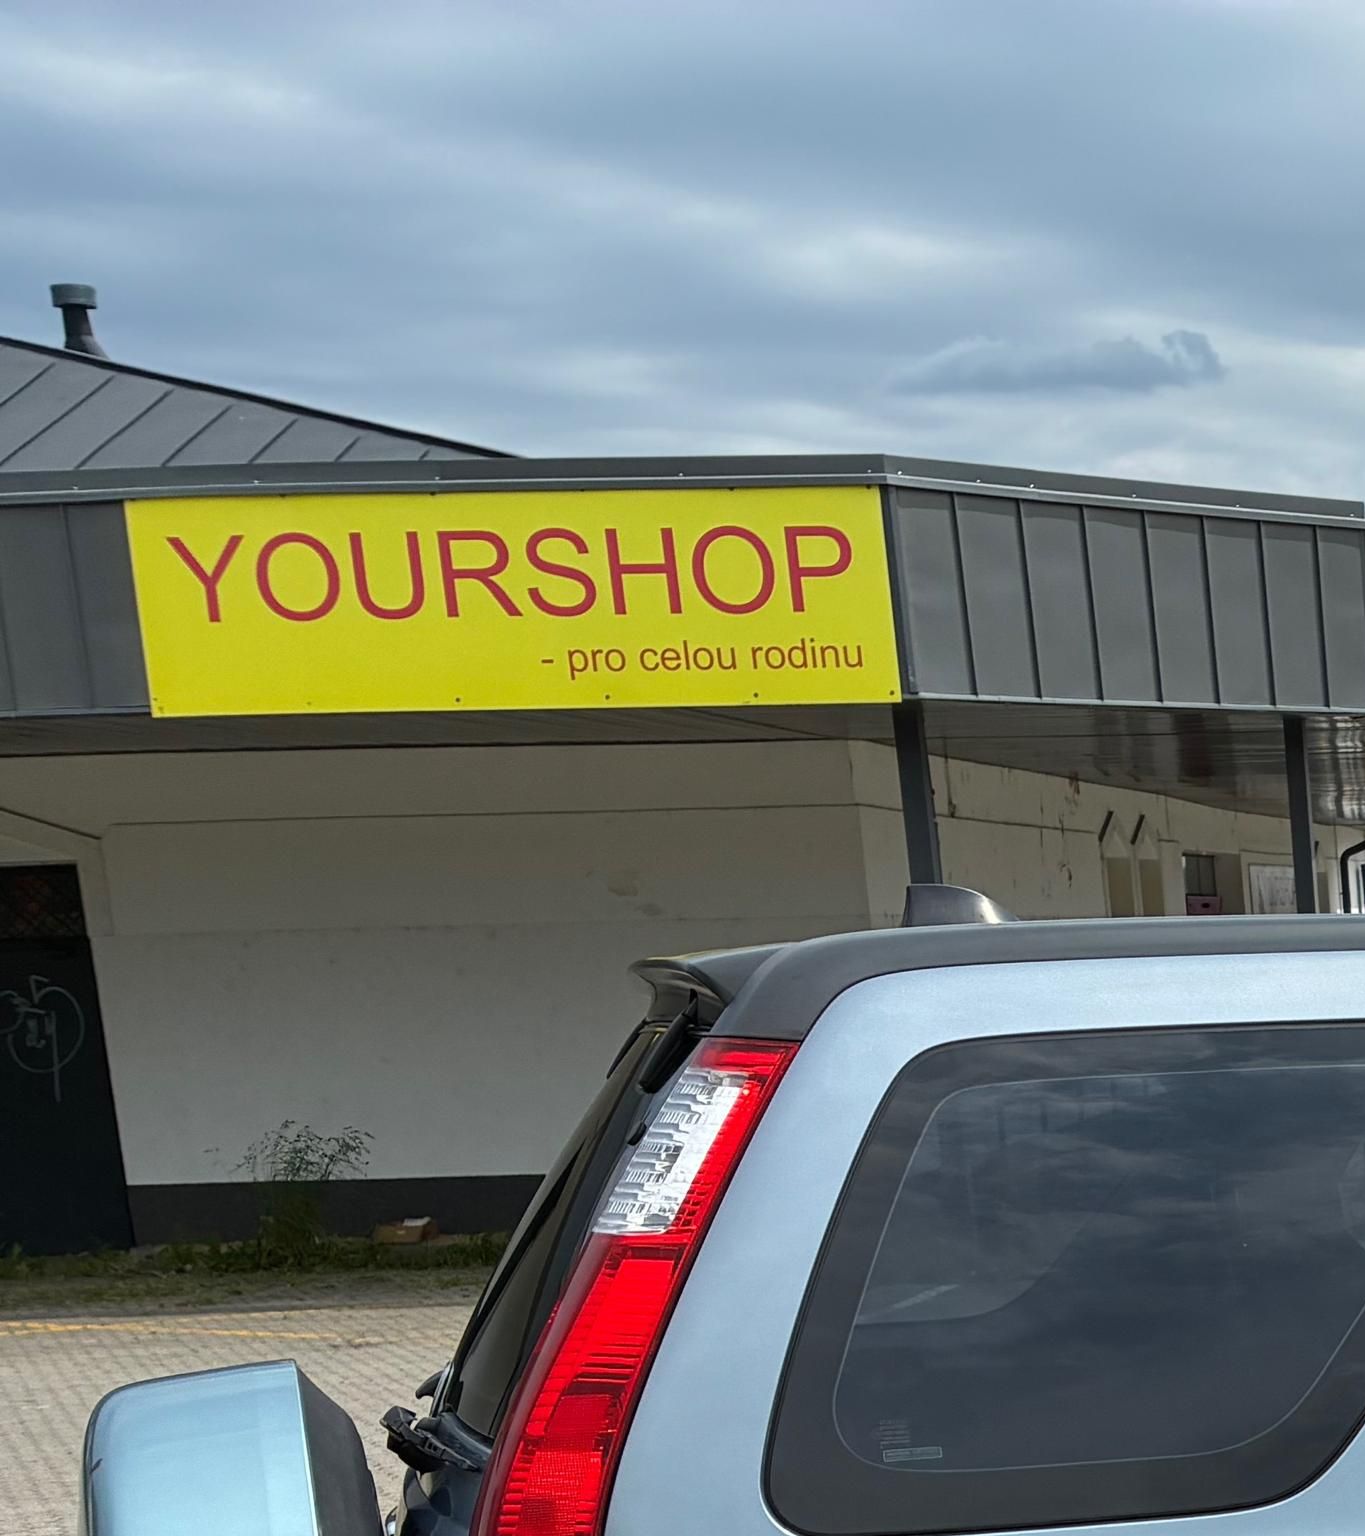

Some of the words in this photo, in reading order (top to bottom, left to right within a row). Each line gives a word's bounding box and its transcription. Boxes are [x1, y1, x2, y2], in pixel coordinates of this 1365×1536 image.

[167, 526, 853, 623] YOURSHOP
[567, 648, 626, 681] pro
[639, 639, 737, 672] celou
[751, 637, 864, 670] rodinu
